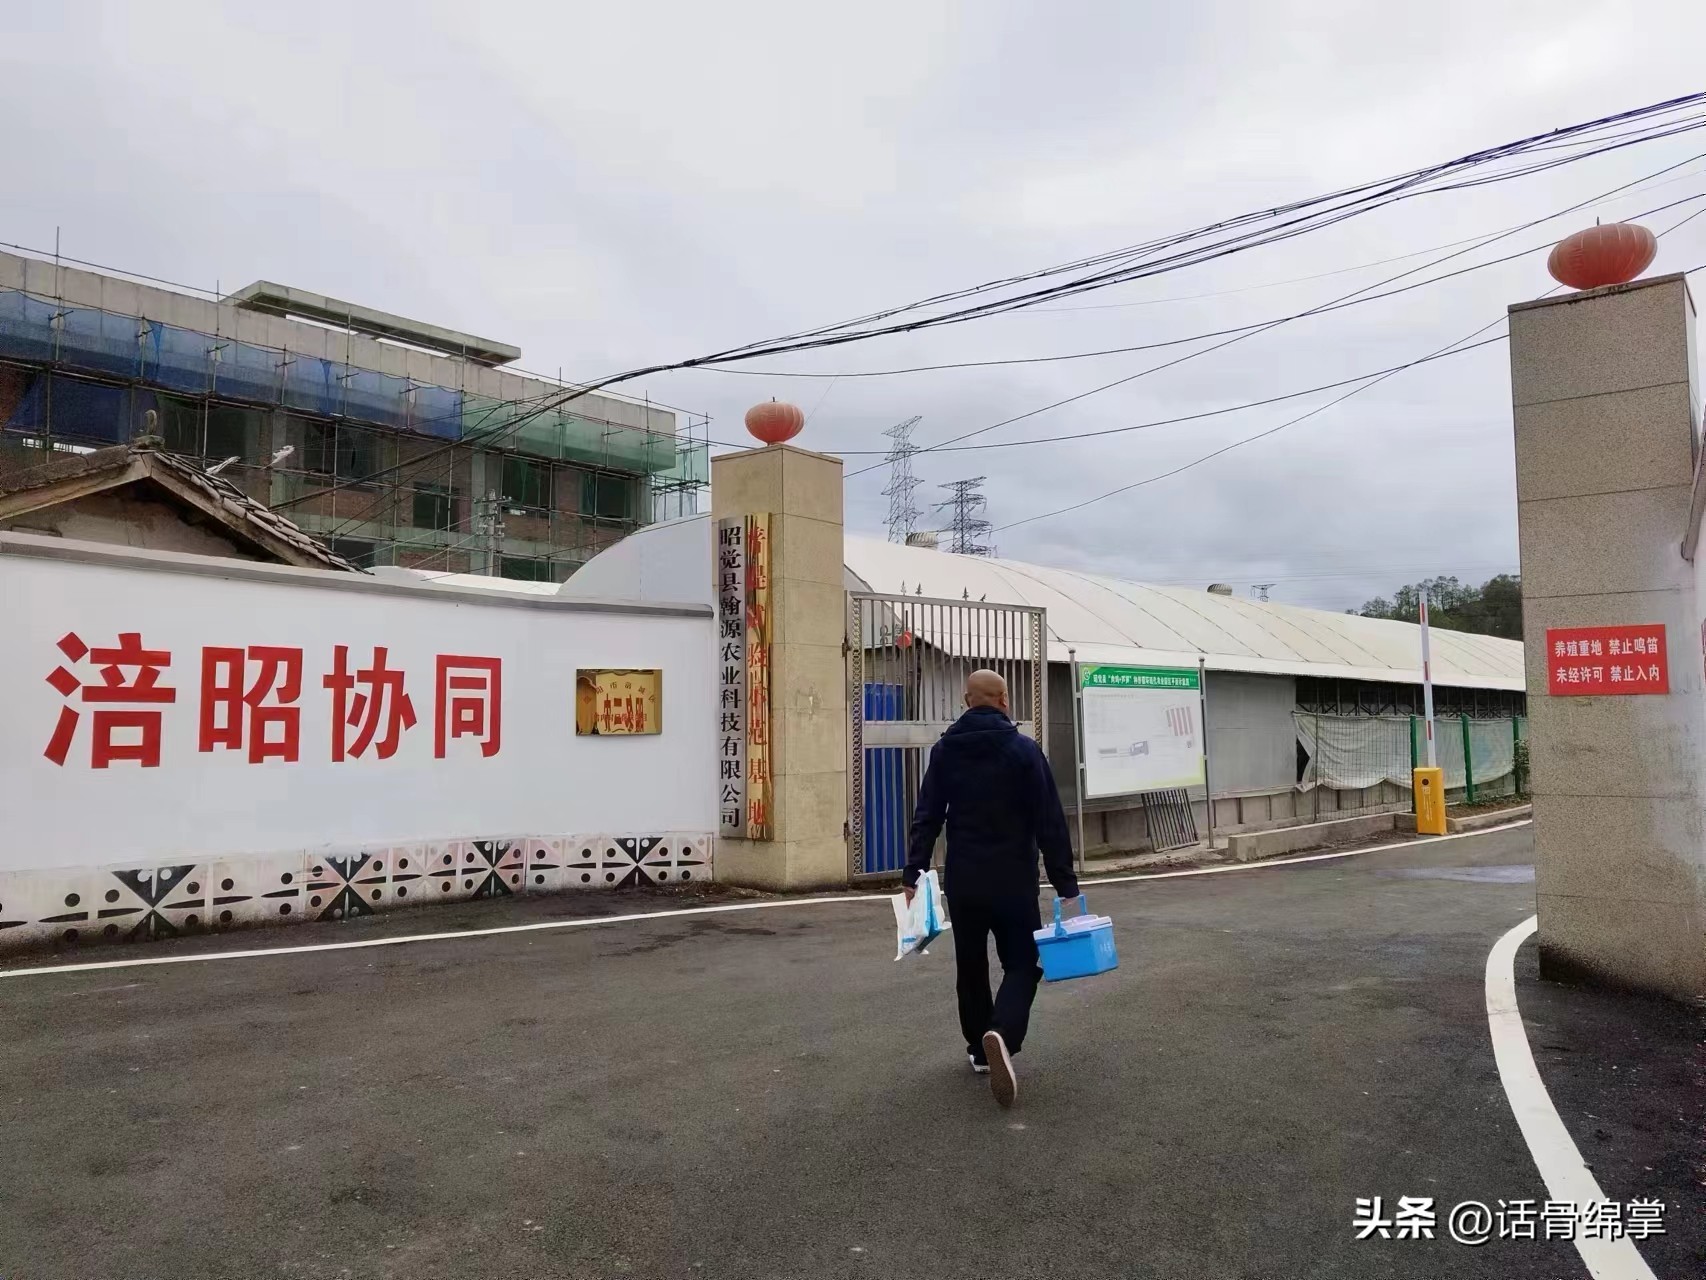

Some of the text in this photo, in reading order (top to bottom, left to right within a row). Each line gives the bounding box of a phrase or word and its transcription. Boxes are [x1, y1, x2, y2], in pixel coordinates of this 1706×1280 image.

[720, 526, 742, 828] 昭觉县翰源农业科技有限公司
[1555, 636, 1659, 657] 养殖重地 禁止鸣笛
[1556, 664, 1660, 683] 未经许可 禁止入内
[44, 631, 504, 769] 涪昭协同
